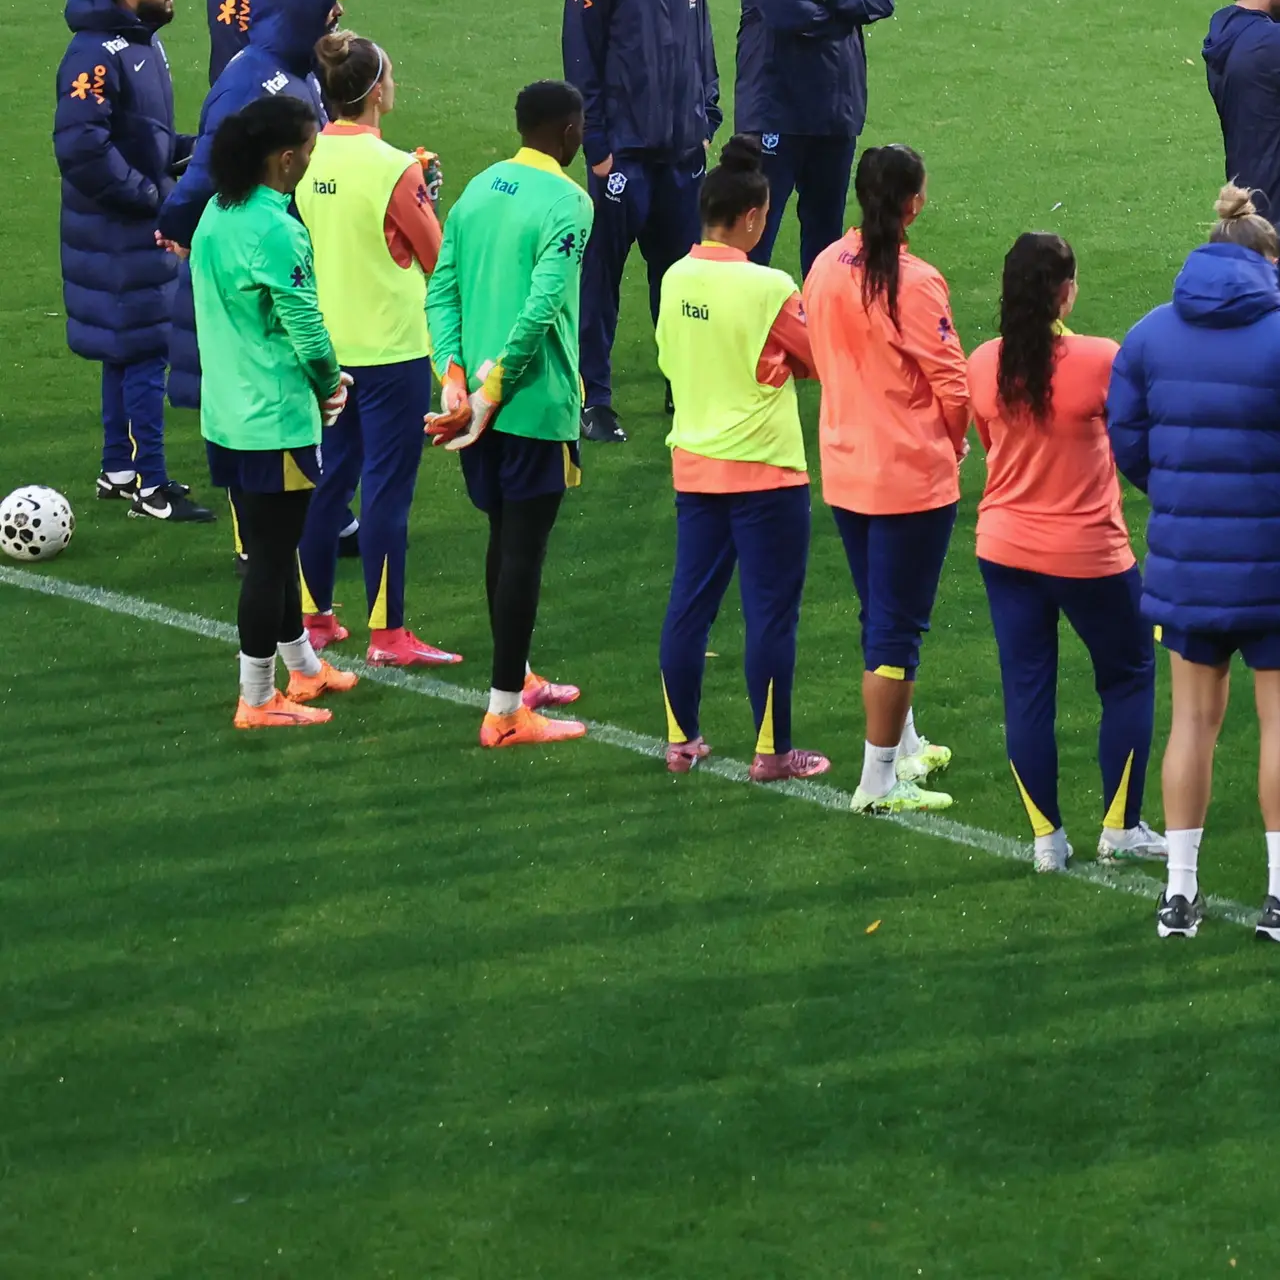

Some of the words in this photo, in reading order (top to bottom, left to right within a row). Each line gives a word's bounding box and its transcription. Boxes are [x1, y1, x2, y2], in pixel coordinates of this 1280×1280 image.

[91, 64, 106, 104] vivo
[313, 178, 337, 195] itaú
[491, 177, 519, 196] itaú
[682, 299, 709, 321] itaú
